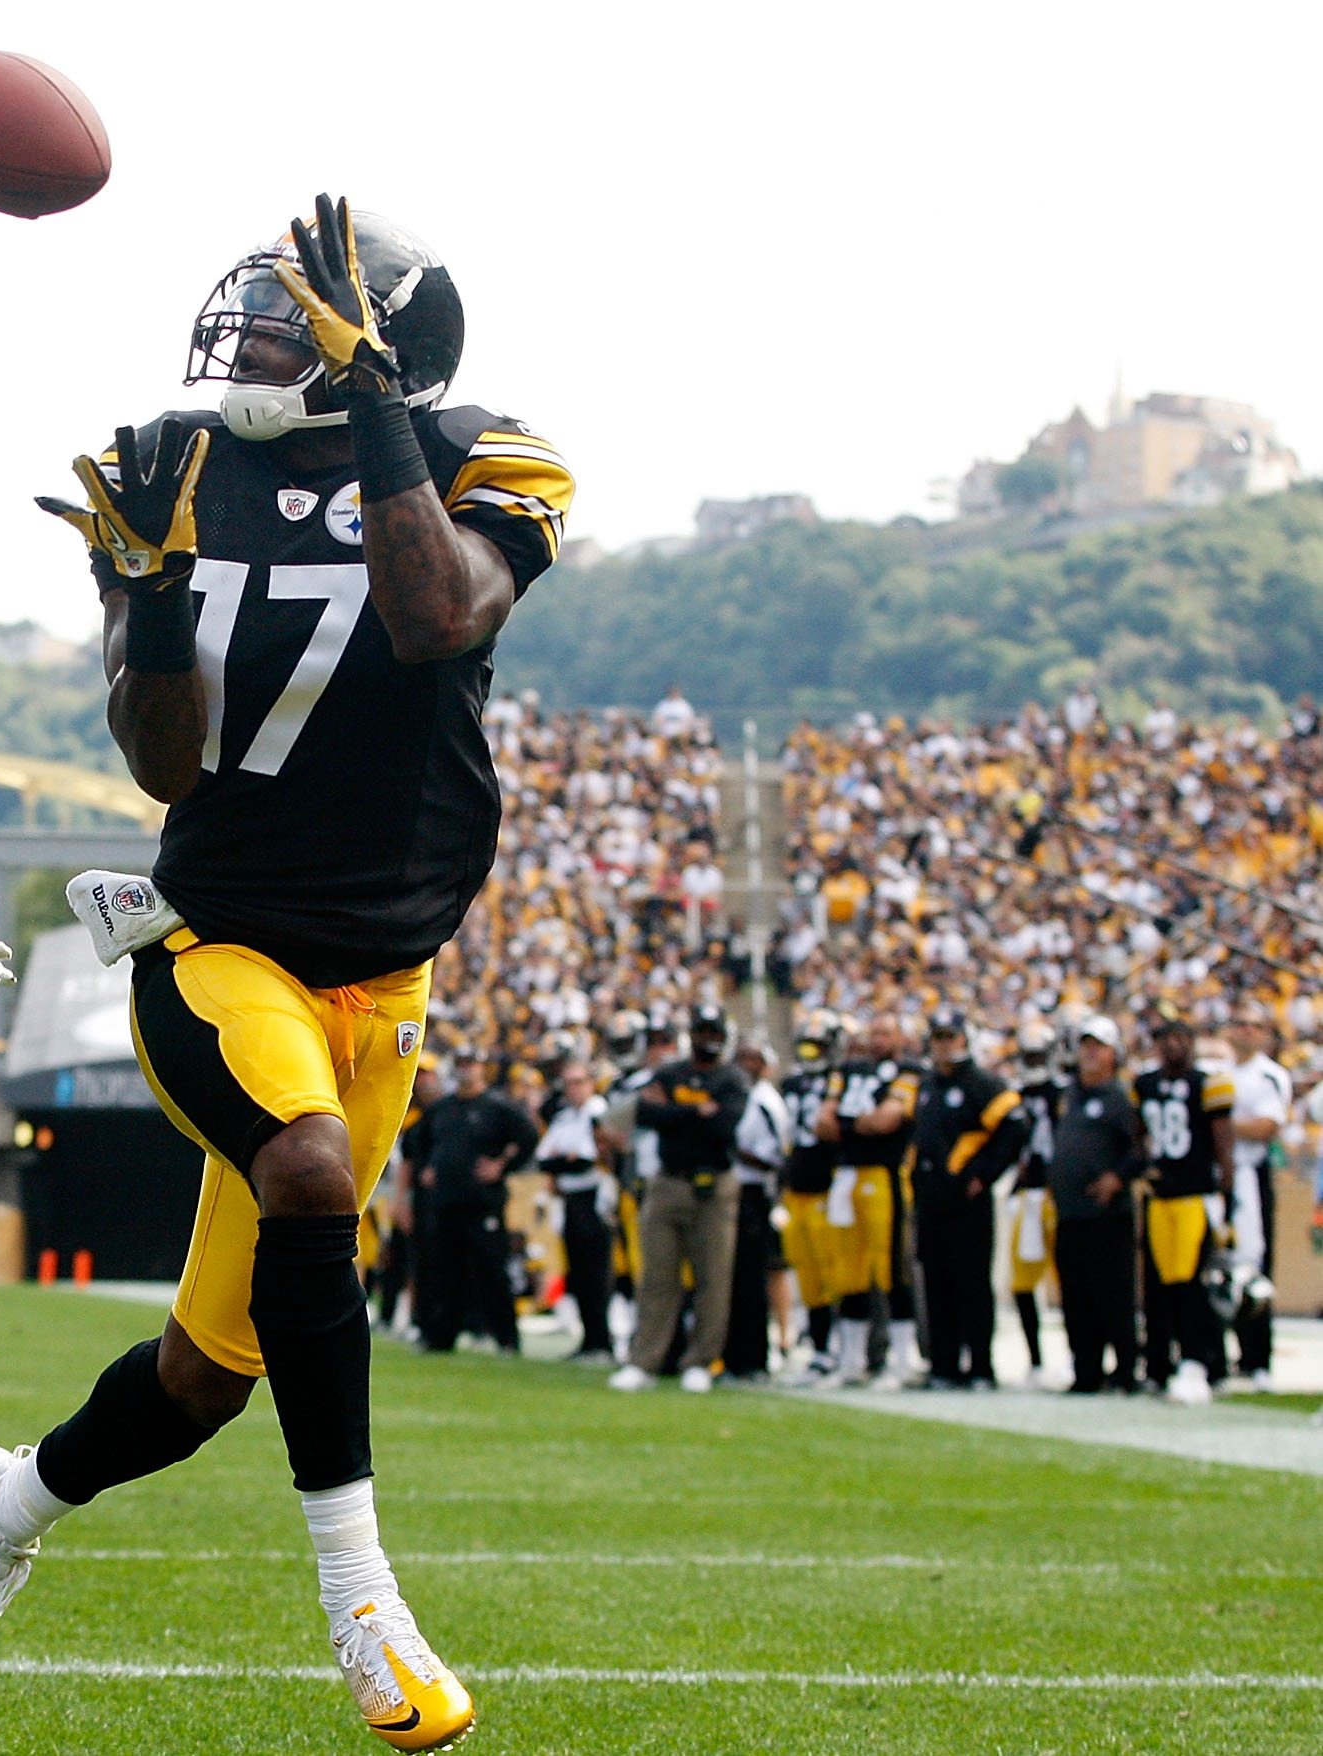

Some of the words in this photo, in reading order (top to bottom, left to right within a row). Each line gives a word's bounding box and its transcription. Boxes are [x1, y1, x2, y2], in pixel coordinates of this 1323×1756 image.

[331, 508, 355, 517] Steelers
[189, 557, 370, 776] 17
[92, 883, 115, 938] Wilson
